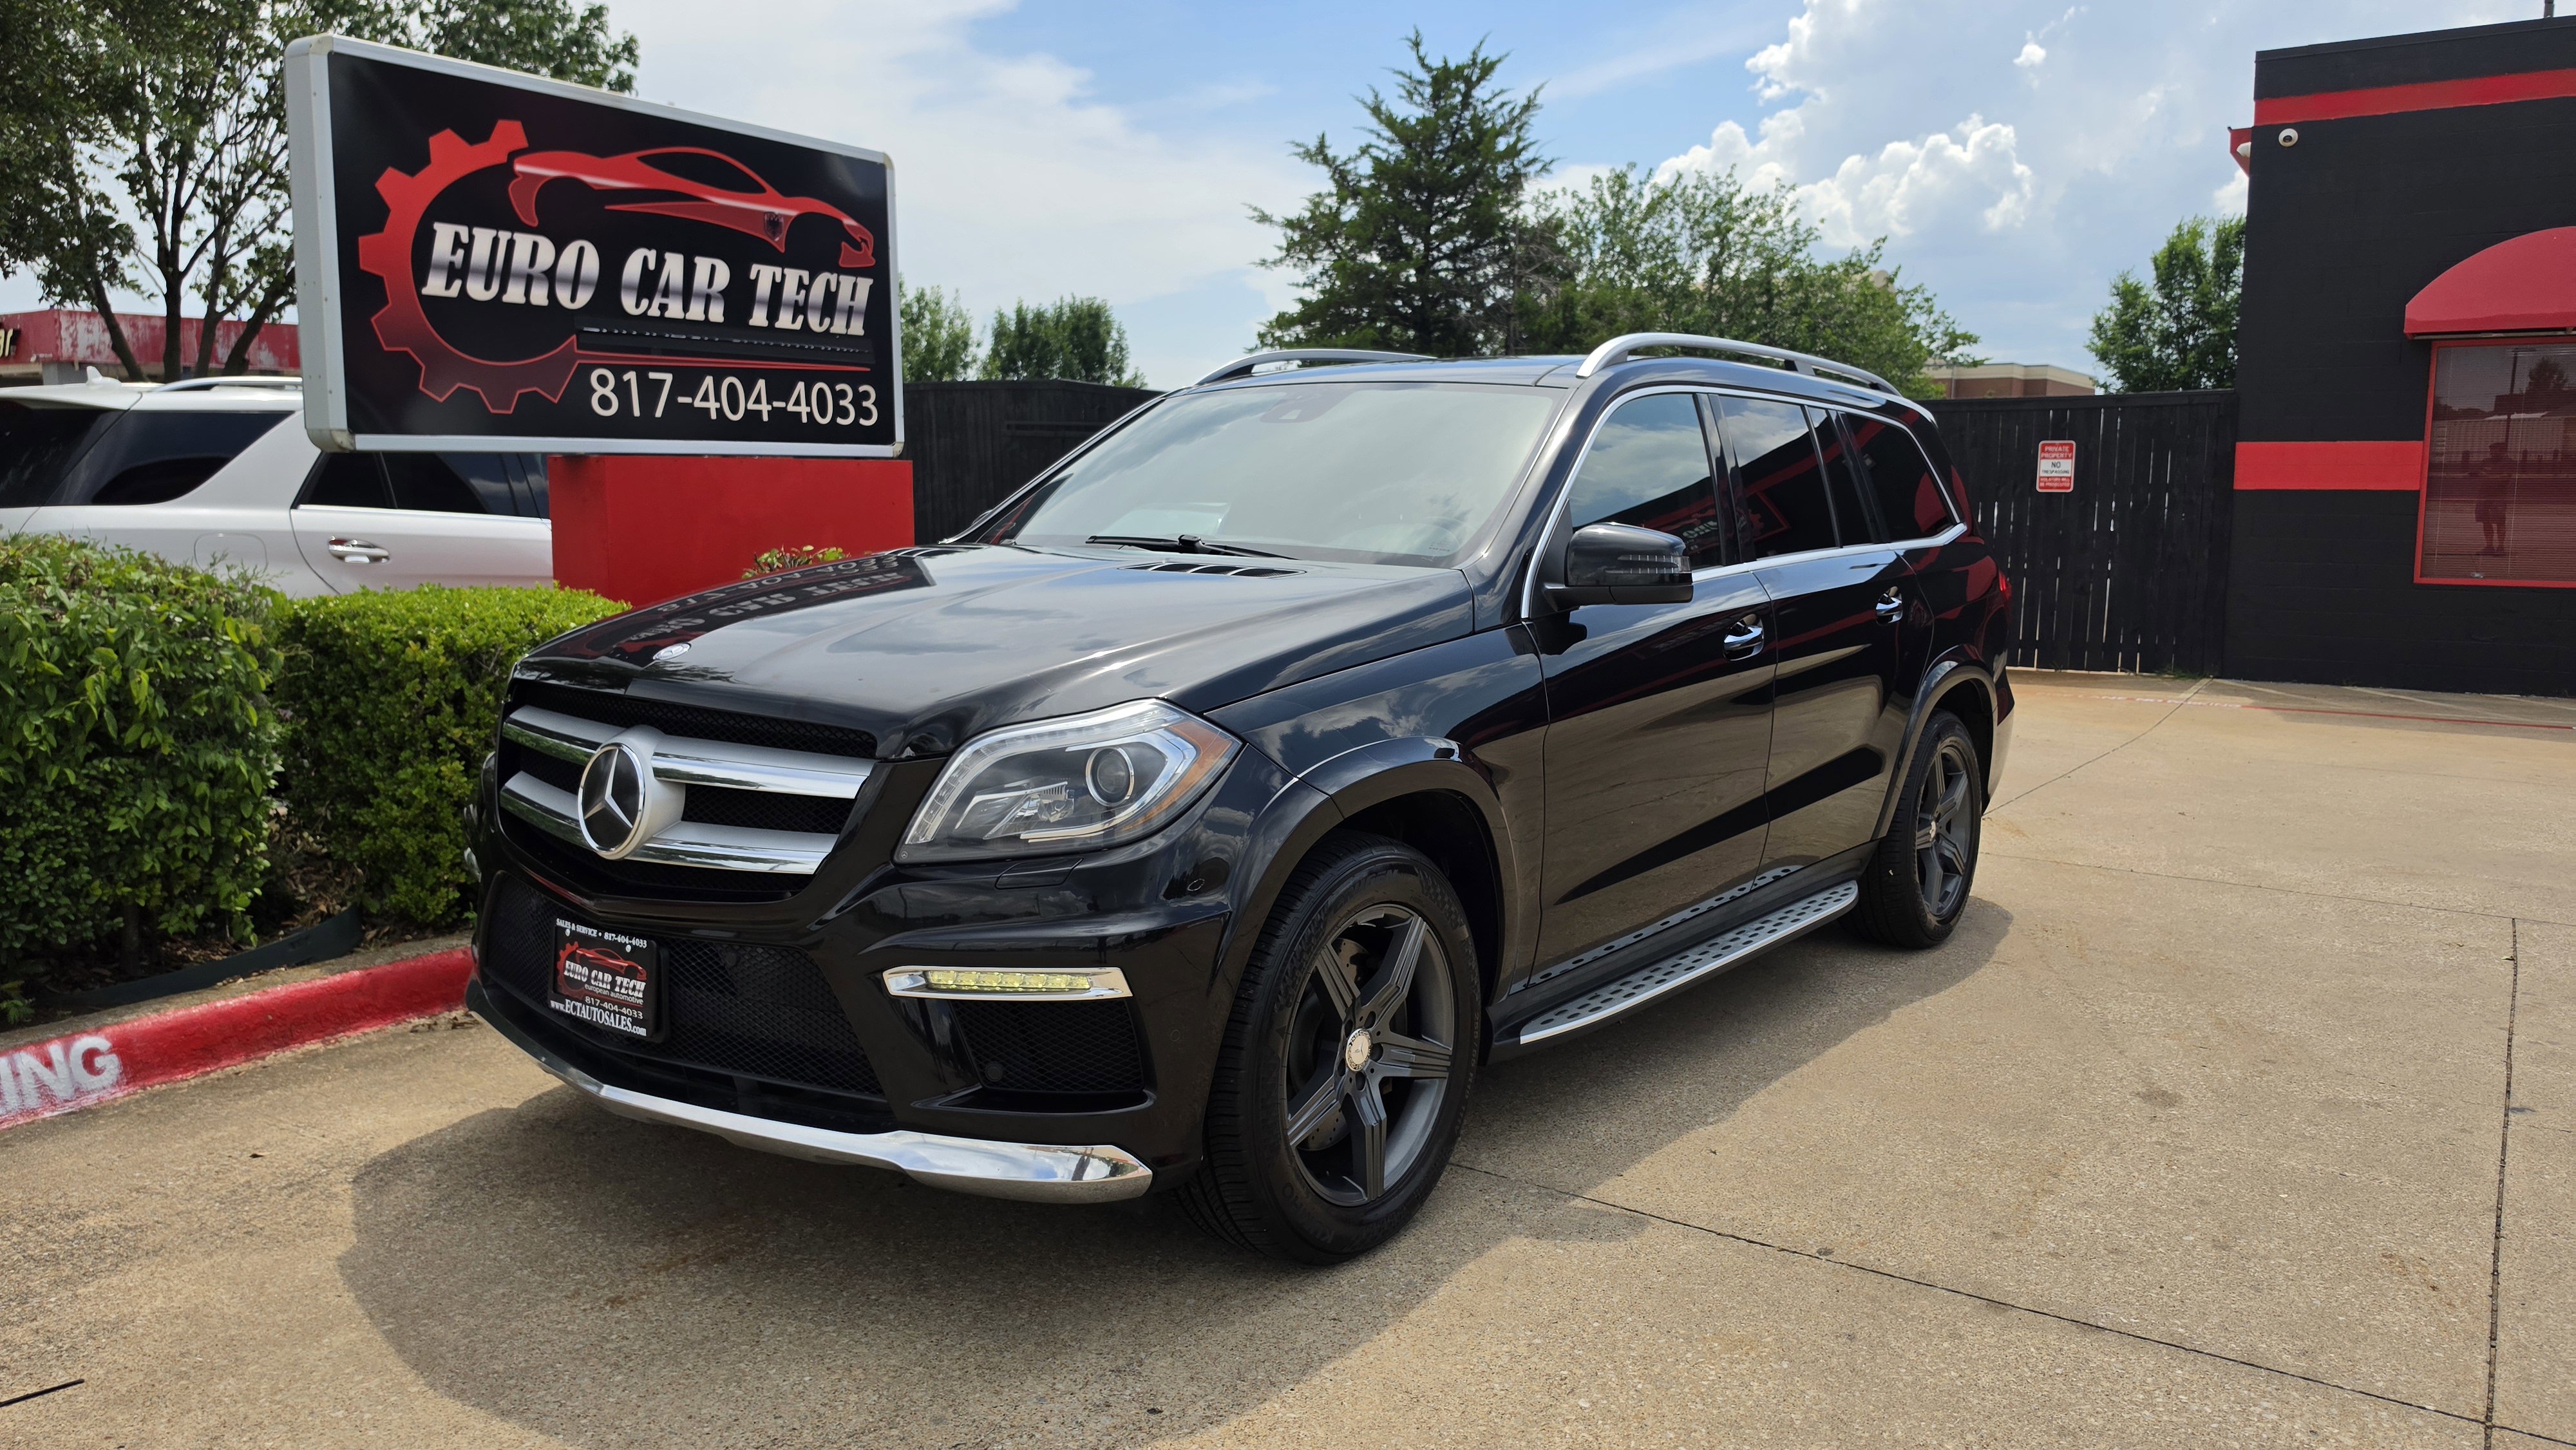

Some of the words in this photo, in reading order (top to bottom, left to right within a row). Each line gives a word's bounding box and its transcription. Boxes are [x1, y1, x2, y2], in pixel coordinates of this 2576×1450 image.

[422, 221, 600, 310] EURO
[621, 247, 730, 323] CAR
[749, 263, 873, 336] TECH
[591, 368, 878, 426] 817-404-4033
[556, 918, 571, 929] SALES
[571, 923, 576, 931] &
[576, 925, 597, 937] SERVICE
[603, 932, 647, 948] 817-404-4033
[564, 960, 589, 983] EURO
[591, 970, 612, 990] CAR
[614, 975, 647, 997] TECH
[585, 983, 609, 997] european
[610, 990, 644, 1005] automotive
[550, 999, 647, 1037] www.ECTAUTOSALES.com
[585, 996, 643, 1019] 817-404-4033
